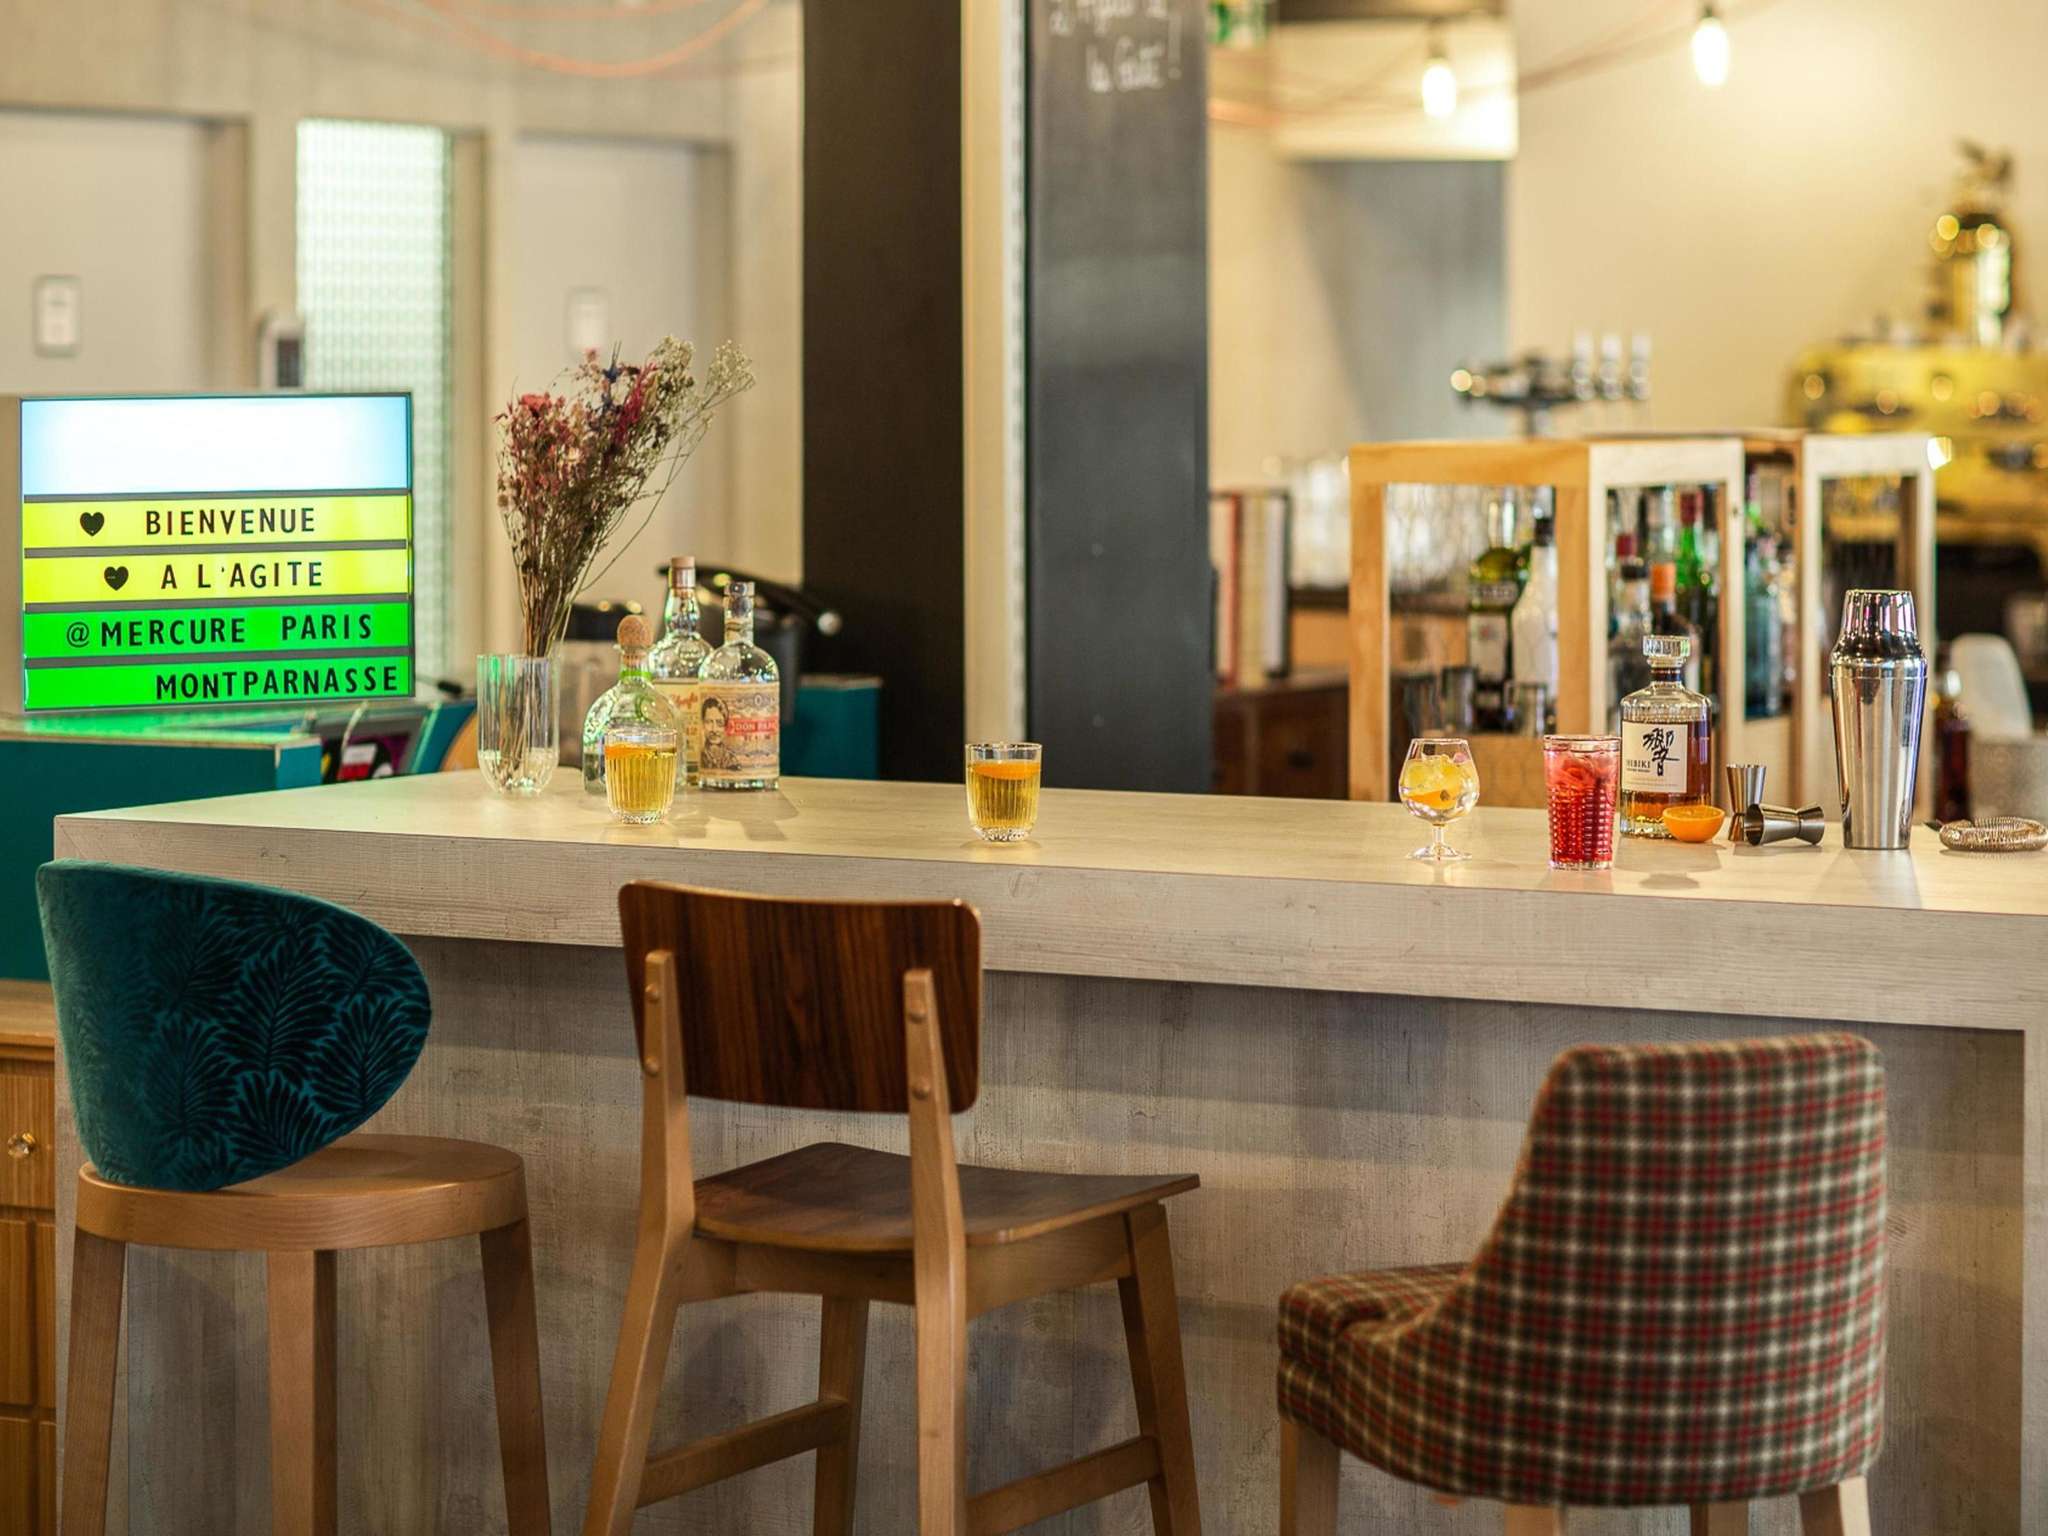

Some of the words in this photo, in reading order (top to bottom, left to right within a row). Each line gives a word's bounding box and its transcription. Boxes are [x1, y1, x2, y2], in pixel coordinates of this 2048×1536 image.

[146, 507, 315, 536] BIENVENUE
[160, 564, 178, 590] A
[281, 613, 372, 641] PARIS
[156, 665, 398, 700] MONTPARNASSE
